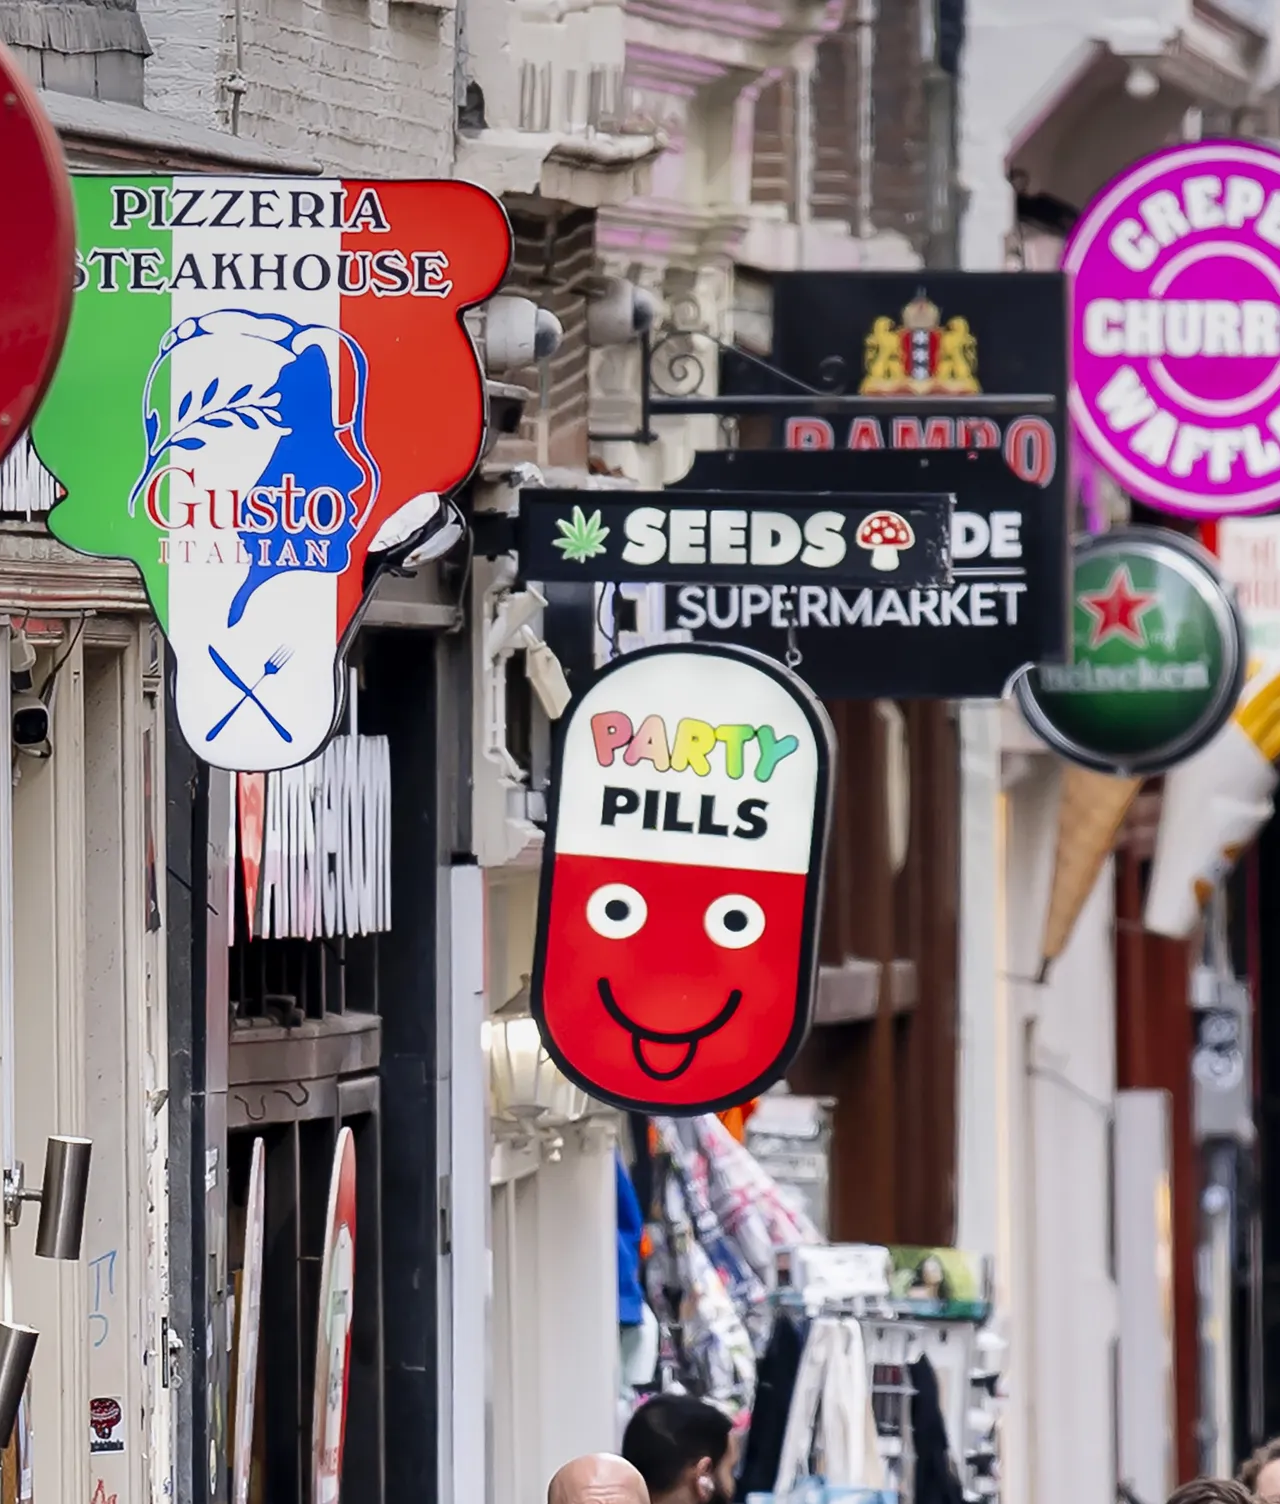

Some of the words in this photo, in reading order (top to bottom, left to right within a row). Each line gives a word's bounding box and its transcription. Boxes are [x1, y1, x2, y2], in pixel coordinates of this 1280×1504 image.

[111, 187, 389, 232] PIZZERIA
[144, 467, 346, 533] Gusto
[158, 538, 332, 569] ITALIAN
[622, 507, 847, 569] SEEDS
[676, 583, 1028, 629] SUPERMARKET
[590, 711, 799, 782] PARTY
[600, 785, 769, 840] PILLS
